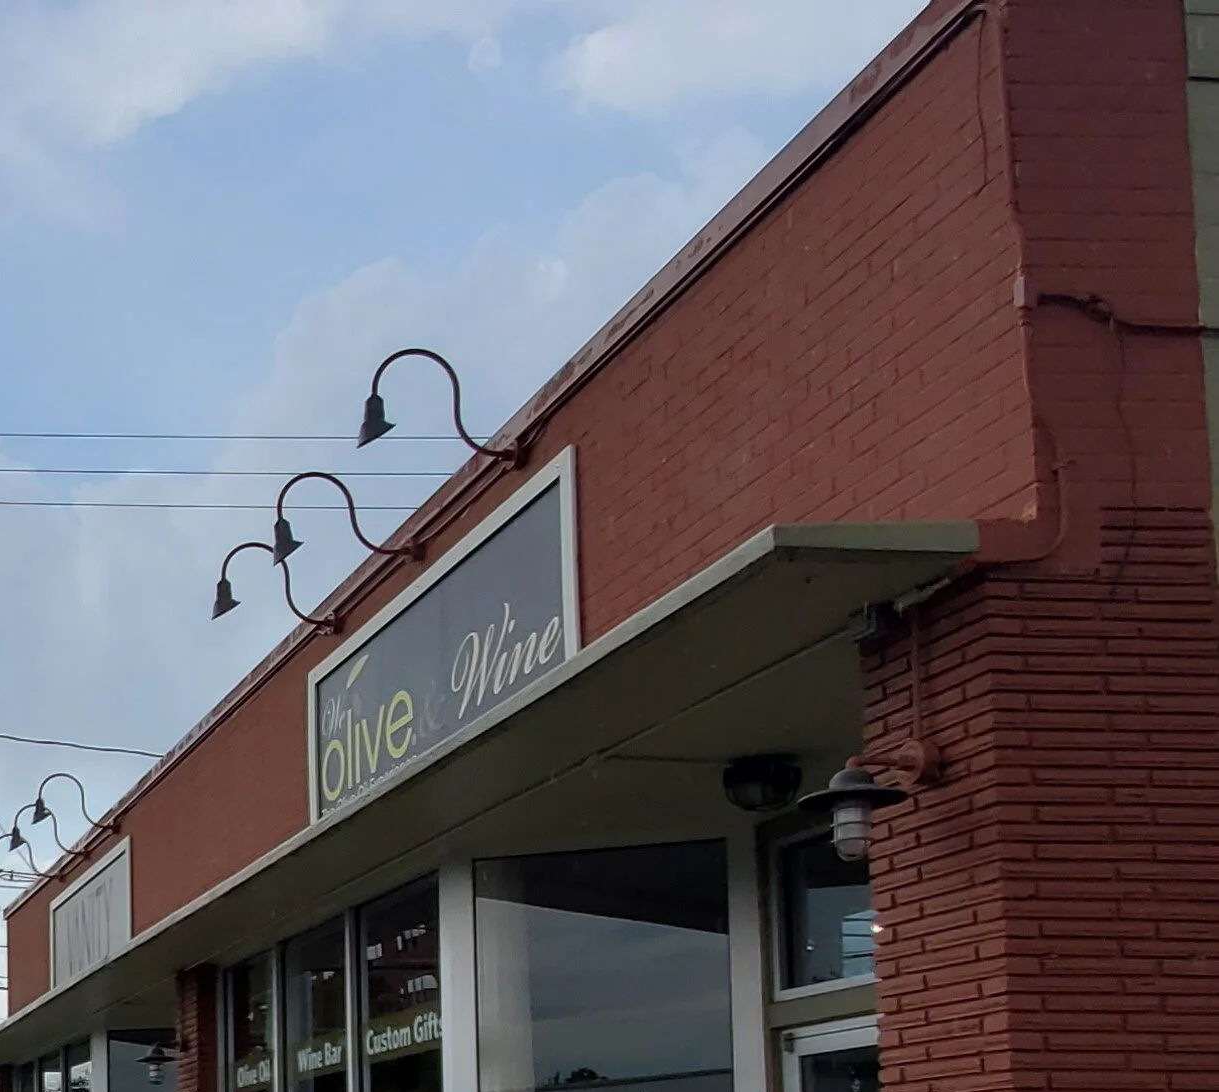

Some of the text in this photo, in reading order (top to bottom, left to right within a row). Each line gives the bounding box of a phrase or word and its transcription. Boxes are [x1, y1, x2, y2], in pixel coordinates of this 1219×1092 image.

[321, 690, 413, 801] olive
[451, 602, 563, 719] Wine
[366, 1025, 411, 1056] Custom
[297, 1043, 342, 1073] Wine Bar
[237, 1064, 258, 1088] Olive
